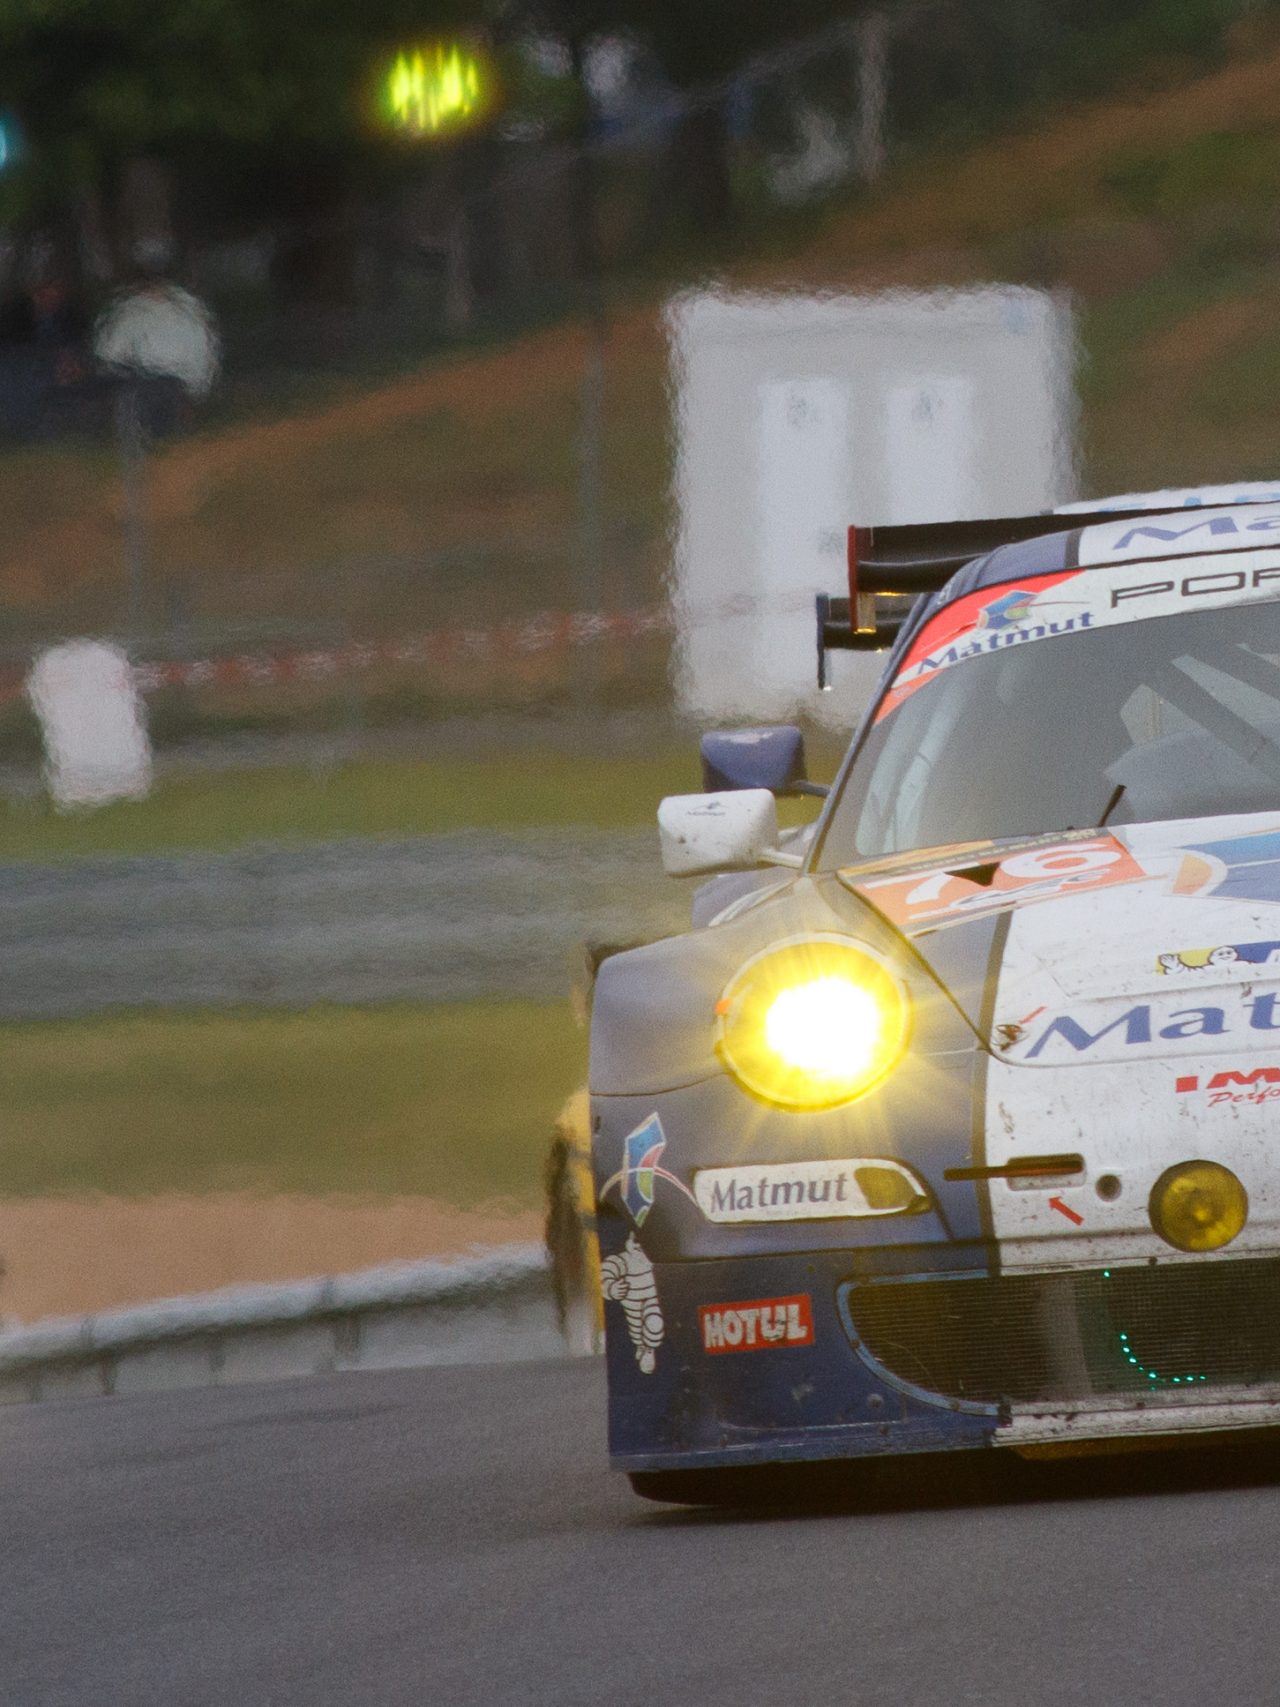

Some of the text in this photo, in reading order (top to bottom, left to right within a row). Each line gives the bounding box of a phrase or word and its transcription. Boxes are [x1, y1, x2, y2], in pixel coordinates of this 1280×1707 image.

[918, 611, 1095, 675] Matmut
[709, 1171, 848, 1213] Matmut
[704, 1303, 808, 1349] MOTUL
